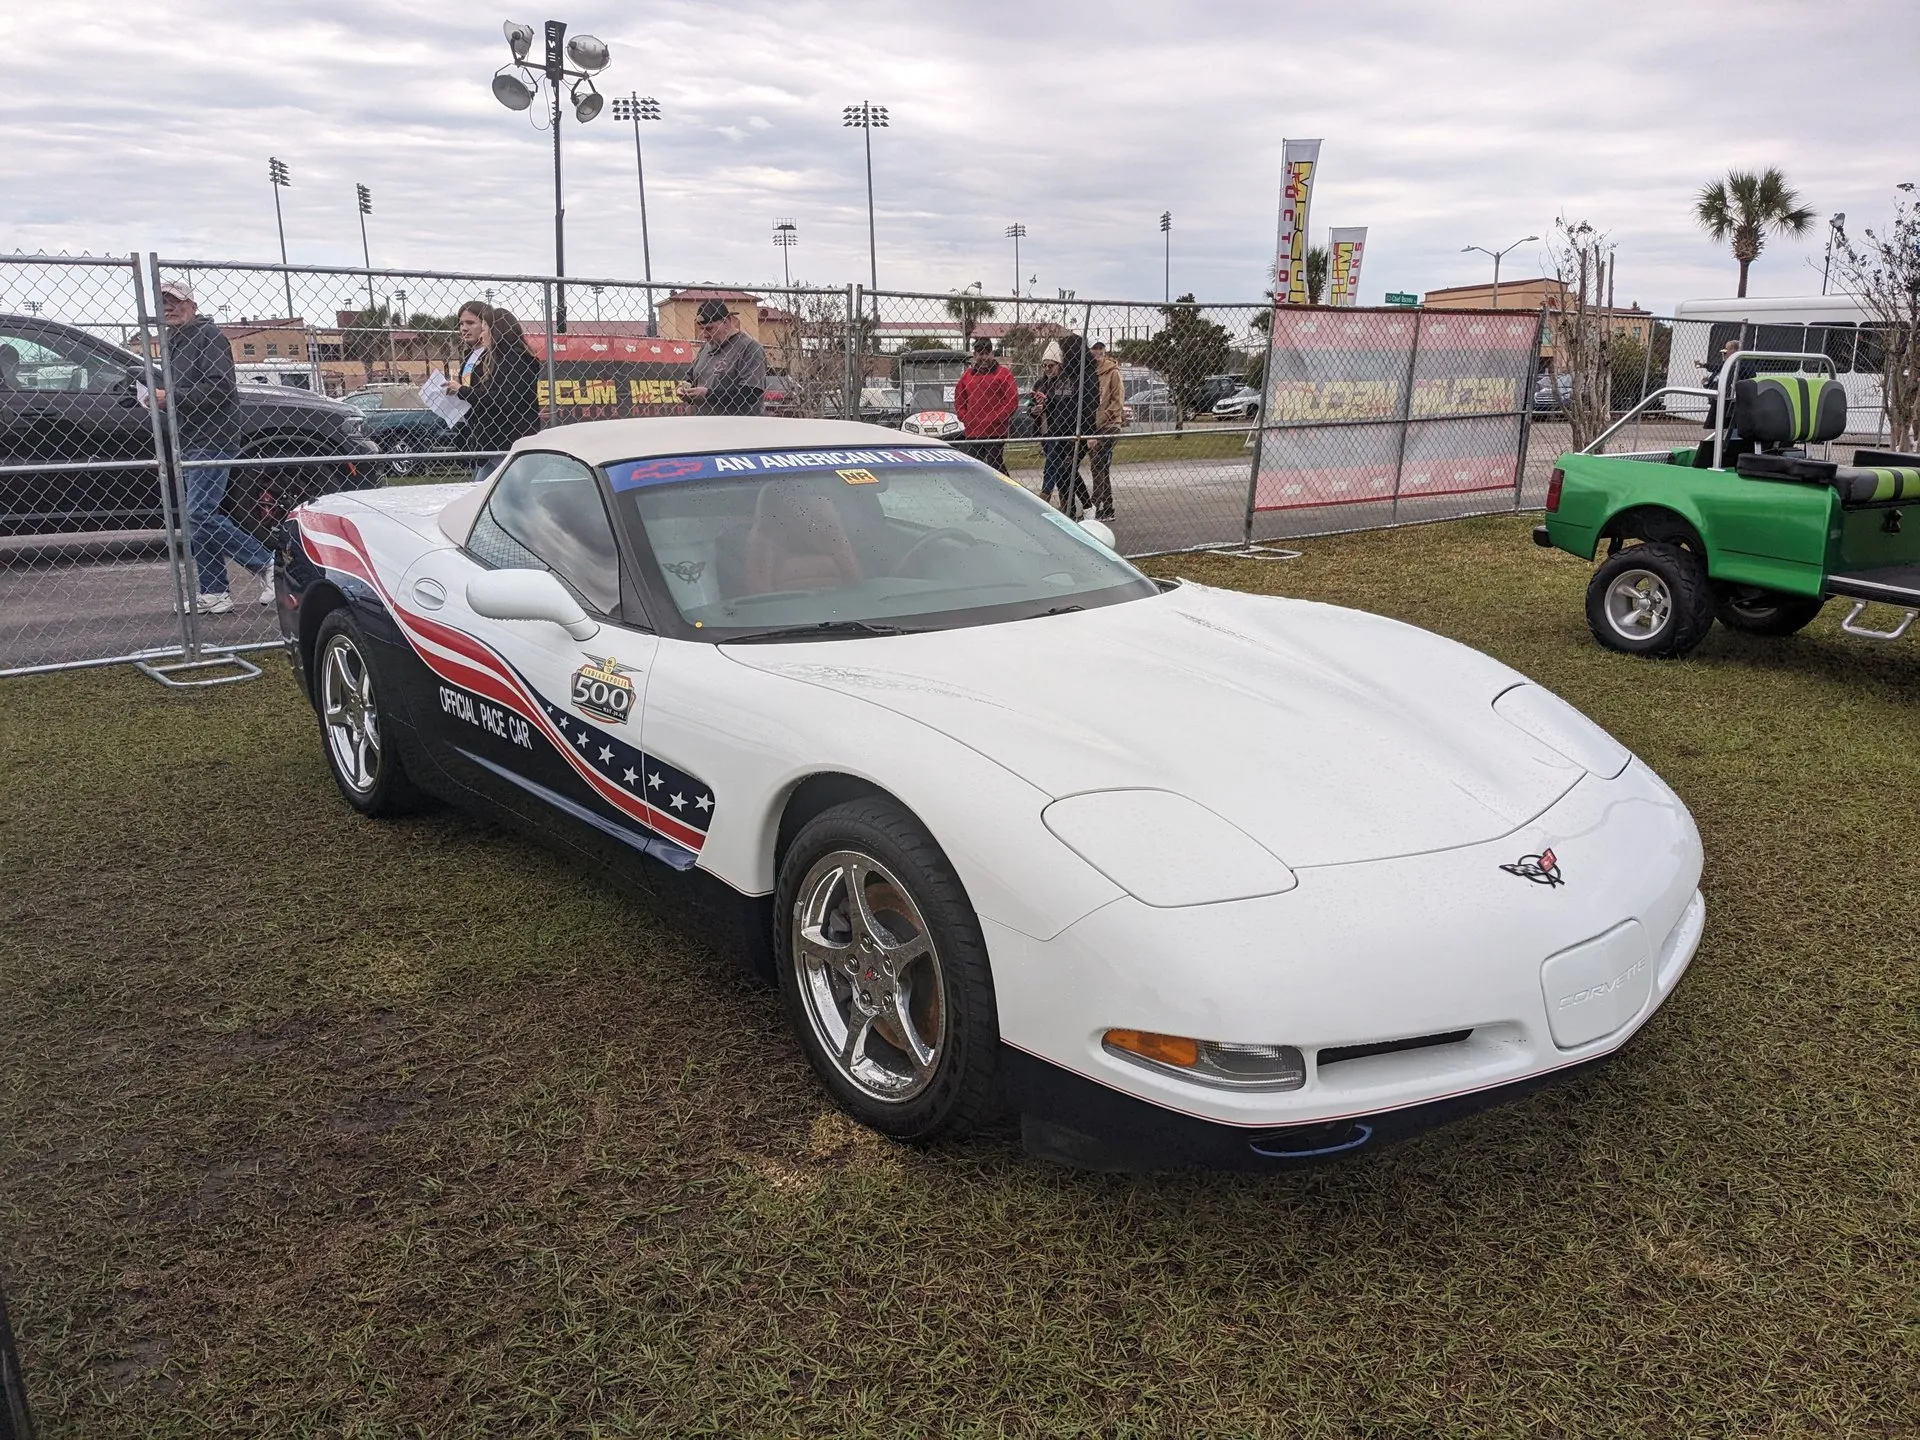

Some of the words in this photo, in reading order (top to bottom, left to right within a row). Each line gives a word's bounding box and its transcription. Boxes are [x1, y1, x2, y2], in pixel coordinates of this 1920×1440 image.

[714, 456, 757, 473] AN
[759, 451, 884, 469] AMERICAN
[842, 472, 873, 481] NR
[584, 667, 628, 687] INDIANAPOLIS
[573, 675, 629, 712] 500
[439, 685, 480, 726] OFFICIAL
[480, 702, 508, 739] PACE
[508, 715, 533, 750] CAR
[1558, 954, 1648, 1011] CORVETTE
